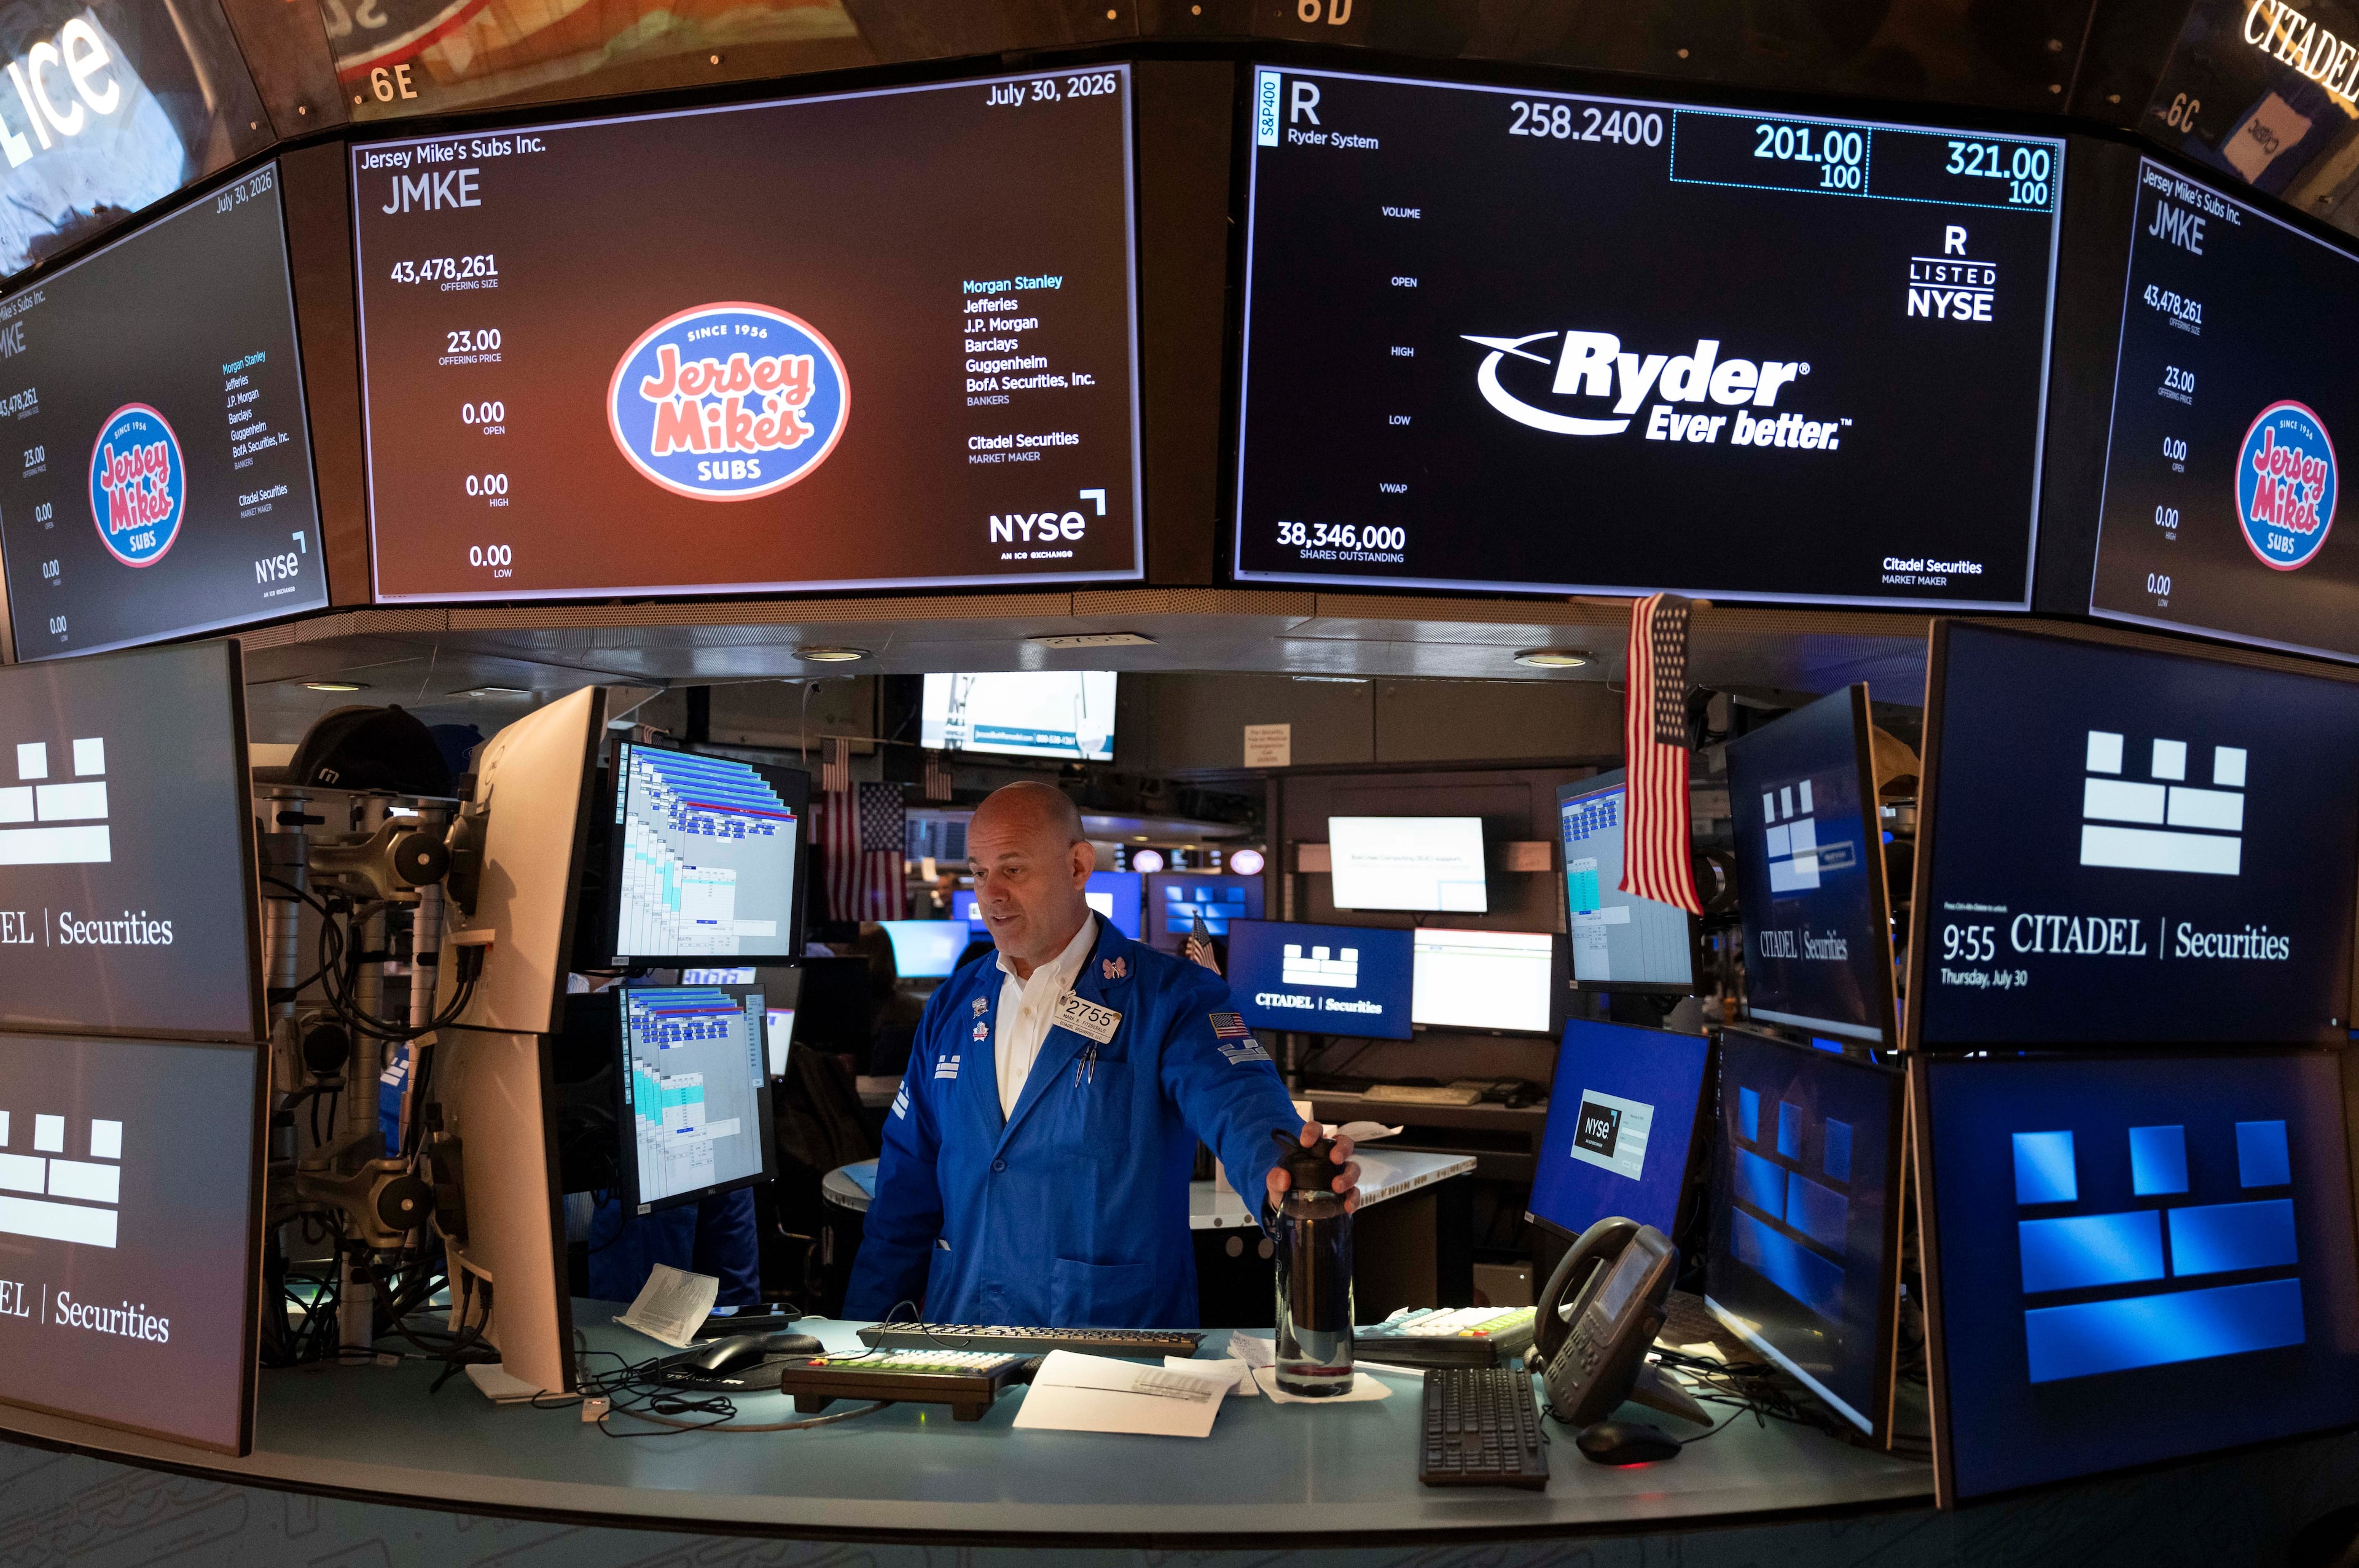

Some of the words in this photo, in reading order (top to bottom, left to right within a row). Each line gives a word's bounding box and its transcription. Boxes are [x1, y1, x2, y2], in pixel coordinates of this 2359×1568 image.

[370, 63, 418, 102] 6E
[986, 85, 1025, 106] July
[1031, 80, 1062, 103] 30,
[1067, 73, 1116, 98] 2026
[1262, 82, 1276, 136] S&P400
[1291, 80, 1321, 125] R
[2167, 92, 2200, 133] 6C
[1508, 101, 1663, 147] 258.2400
[1288, 128, 1328, 146] Ryder
[1331, 133, 1379, 151] System
[1754, 124, 1862, 165] 201.00
[361, 150, 411, 170] Jersey
[417, 142, 467, 163] Mike's
[471, 138, 512, 158] Subs
[517, 135, 546, 153] Inc.
[1946, 141, 2050, 182] 321.00
[1820, 165, 1861, 190] 100
[216, 192, 233, 214] July
[235, 184, 249, 204] 30,
[251, 171, 272, 197] 2026
[382, 168, 482, 214] JMKE
[2008, 181, 2048, 205] 100
[2143, 166, 2173, 197] Jersey
[2175, 179, 2202, 208] Mike's
[2204, 195, 2224, 219] Subs
[2226, 204, 2241, 226] Inc.
[1382, 206, 1420, 219] VOLUME
[2149, 200, 2205, 255] JMKE
[1944, 225, 1967, 255] R
[391, 254, 498, 284] 43,478,261
[1910, 263, 1996, 285] LISTED
[440, 281, 479, 291] OFFERING
[481, 279, 498, 289] SIZE
[963, 279, 1011, 295] Morgan
[1014, 274, 1063, 292] Stanley
[1391, 276, 1417, 287] OPEN
[17, 296, 33, 313] Subs
[33, 291, 45, 306] Inc.
[963, 298, 1019, 314] Jefferies
[1907, 288, 1994, 322] NYSE
[2143, 284, 2202, 324] 43,478,261
[687, 324, 727, 341] SINCE
[734, 324, 768, 339] 1956
[964, 319, 986, 333] J.P.
[989, 316, 1038, 333] Morgan
[2169, 317, 2191, 333] OFFERING
[447, 329, 501, 353] 23.00
[964, 338, 1019, 353] Barclays
[1391, 346, 1414, 357] HIGH
[222, 357, 245, 375] Morgan
[245, 351, 266, 369] Stanley
[439, 354, 477, 366] OFFERING
[479, 352, 502, 364] PRICE
[966, 356, 1047, 373] Guggenheim
[225, 375, 248, 391] Jefferies
[639, 343, 815, 405] Jersey
[966, 378, 999, 393] BofA
[1002, 374, 1068, 392] Securities,
[1071, 372, 1095, 387] Inc.
[2164, 365, 2194, 393] 23.00
[227, 396, 236, 408] J.P.
[237, 388, 259, 407] Morgan
[967, 396, 1010, 407] BANKERS
[2158, 387, 2180, 402] OFFERING
[2180, 395, 2193, 406] PRICE
[229, 408, 252, 424] Barclays
[462, 401, 505, 424] 0.00
[1389, 415, 1410, 426] LOW
[114, 424, 130, 440] SINCE
[132, 421, 147, 432] 1956
[231, 421, 267, 442] Guggenheim
[483, 426, 506, 435] OPEN
[651, 393, 815, 457] Mike's
[1646, 404, 1726, 444] Ever
[2280, 419, 2298, 431] SINCE
[233, 443, 248, 458] BofA
[248, 434, 278, 455] Securities,
[278, 431, 289, 443] Inc.
[968, 435, 1013, 450] Citadel
[1016, 432, 1079, 448] Securities
[2164, 437, 2187, 461] 0.00
[24, 445, 45, 468] 23.00
[101, 440, 170, 489] Jersey
[234, 458, 254, 470] BANKERS
[969, 454, 1006, 464] MARKET
[1008, 452, 1041, 462] MAKER
[2172, 462, 2185, 473] OPEN
[2253, 426, 2328, 502] Jersey
[697, 459, 761, 481] SUBS
[239, 491, 259, 507] Citadel
[259, 484, 288, 502] Securities
[466, 474, 508, 496] 0.00
[1379, 483, 1407, 494] VWAP
[36, 502, 52, 523] 0.00
[109, 477, 173, 535] Mike's
[240, 507, 257, 518] MARKET
[257, 504, 272, 515] MAKER
[489, 497, 509, 507] HIGH
[2250, 474, 2320, 536] Mike's
[2156, 505, 2179, 529] 0.00
[130, 531, 156, 552] SUBS
[1277, 521, 1406, 551] 38,346,000
[2165, 531, 2177, 541] HIGH
[2267, 532, 2294, 555] SUBS
[469, 544, 512, 566] 0.00
[1300, 549, 1337, 560] SHARES
[1339, 551, 1404, 564] OUTSTANDING
[1883, 557, 1924, 572] Citadel
[1927, 559, 1982, 575] Securities
[43, 559, 60, 579] 0.00
[494, 569, 512, 579] LOW
[1882, 574, 1916, 585] MARKET
[1917, 575, 1947, 587] MAKER
[2147, 572, 2170, 596] 0.00
[2158, 598, 2169, 607] LOW
[50, 615, 67, 634] 0.00
[60, 910, 173, 945] Securities
[2010, 913, 2147, 956] CITADEL
[2175, 922, 2290, 962] Securities
[1760, 930, 1798, 959] CITADEL
[1804, 930, 1848, 961] Securities
[1943, 924, 1995, 961] 9:55
[1941, 968, 1990, 989] Thursday,
[1992, 969, 2013, 989] July
[2014, 970, 2028, 986] 30
[1066, 1000, 1113, 1026] 2755
[1255, 993, 1314, 1010] CITADEL
[1325, 999, 1382, 1015] Securities
[1060, 1021, 1073, 1030] CITADEL
[1074, 1027, 1093, 1037] SECURITIES
[1082, 1021, 1106, 1033] FITZGERALD
[55, 1290, 170, 1344] Securities
